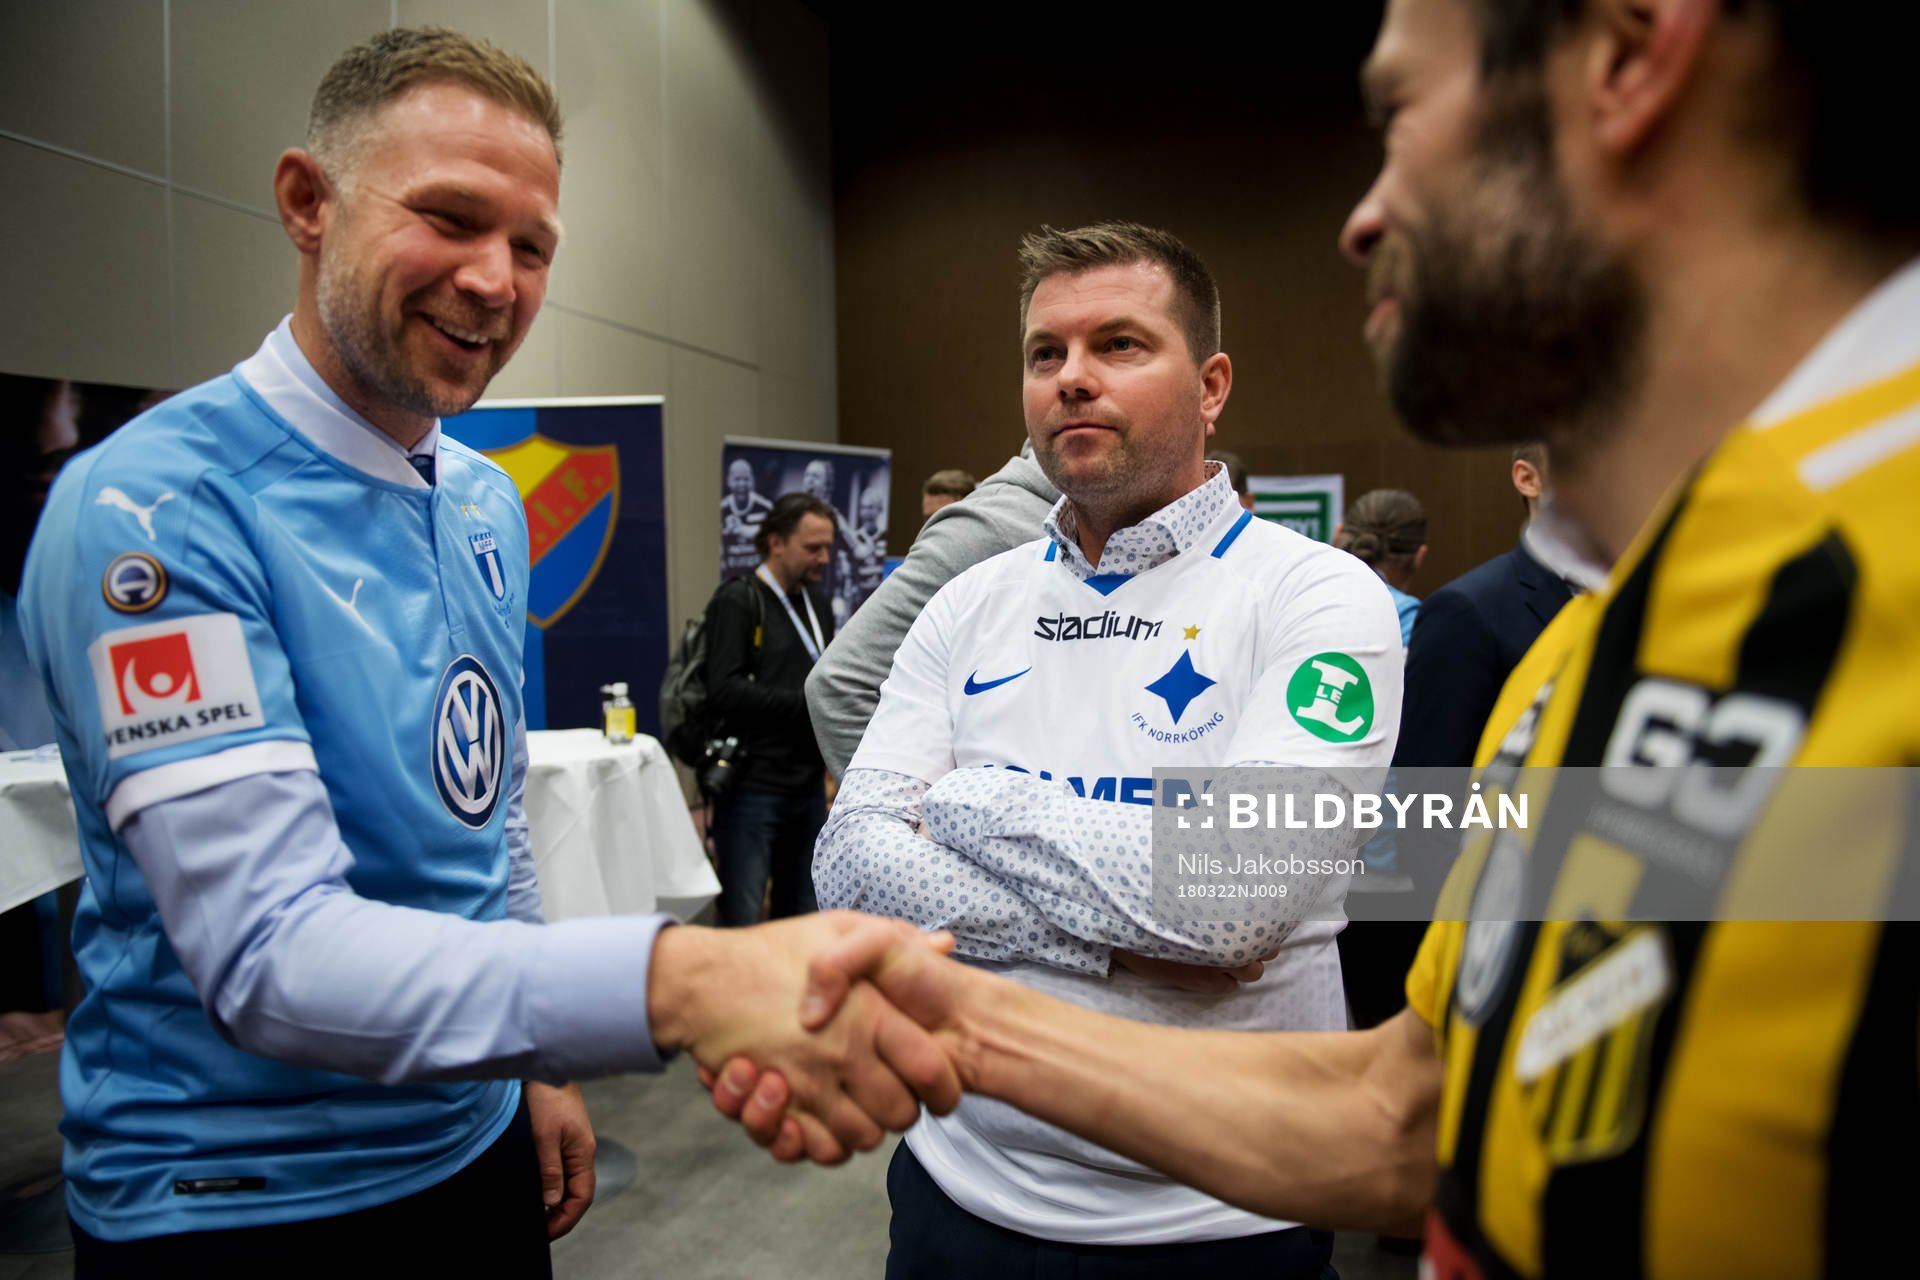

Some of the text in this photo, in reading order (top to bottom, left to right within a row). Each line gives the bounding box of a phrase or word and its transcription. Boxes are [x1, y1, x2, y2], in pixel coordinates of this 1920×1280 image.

[1034, 611, 1164, 642] stadium
[197, 703, 251, 726] SPEL
[1131, 711, 1224, 743] IFK NORRKÖPING
